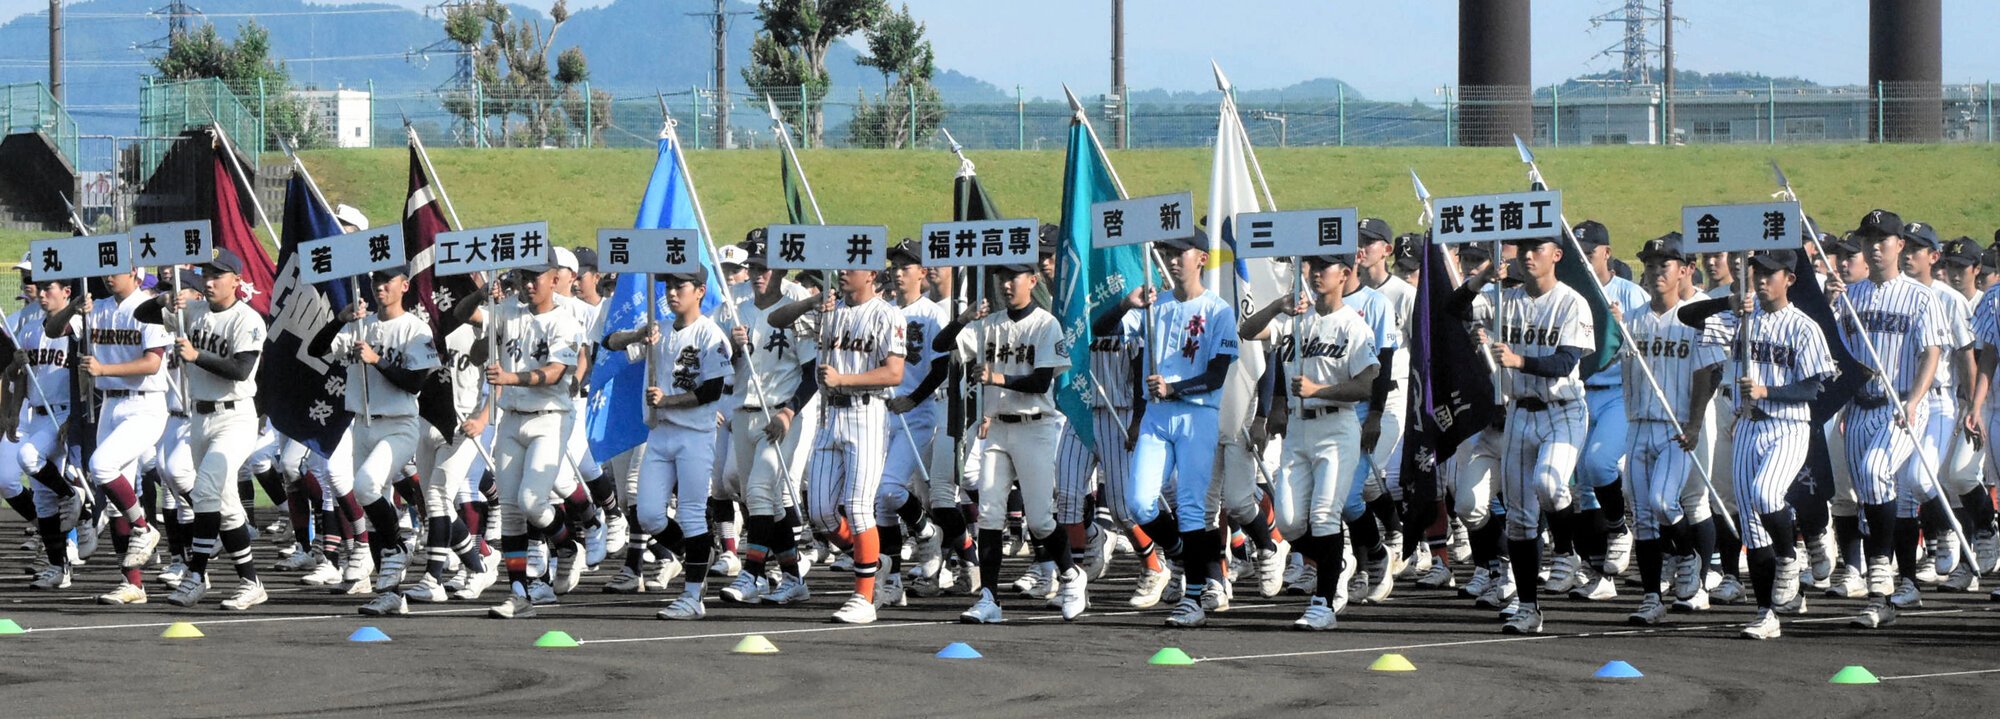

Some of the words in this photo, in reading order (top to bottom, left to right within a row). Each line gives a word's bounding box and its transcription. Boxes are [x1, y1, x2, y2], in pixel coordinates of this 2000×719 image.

[1103, 202, 1182, 239] 啓新
[1250, 217, 1342, 248] 三国
[1439, 200, 1553, 235] 武生商工
[1696, 211, 1786, 244] 金津
[42, 241, 119, 272] 丸岡
[140, 228, 202, 259] 大野
[311, 233, 391, 275] 若狭
[438, 231, 543, 265] 工大福井
[609, 237, 687, 265] 高志
[779, 233, 873, 264] 坂井
[928, 226, 1031, 260] 福井高専
